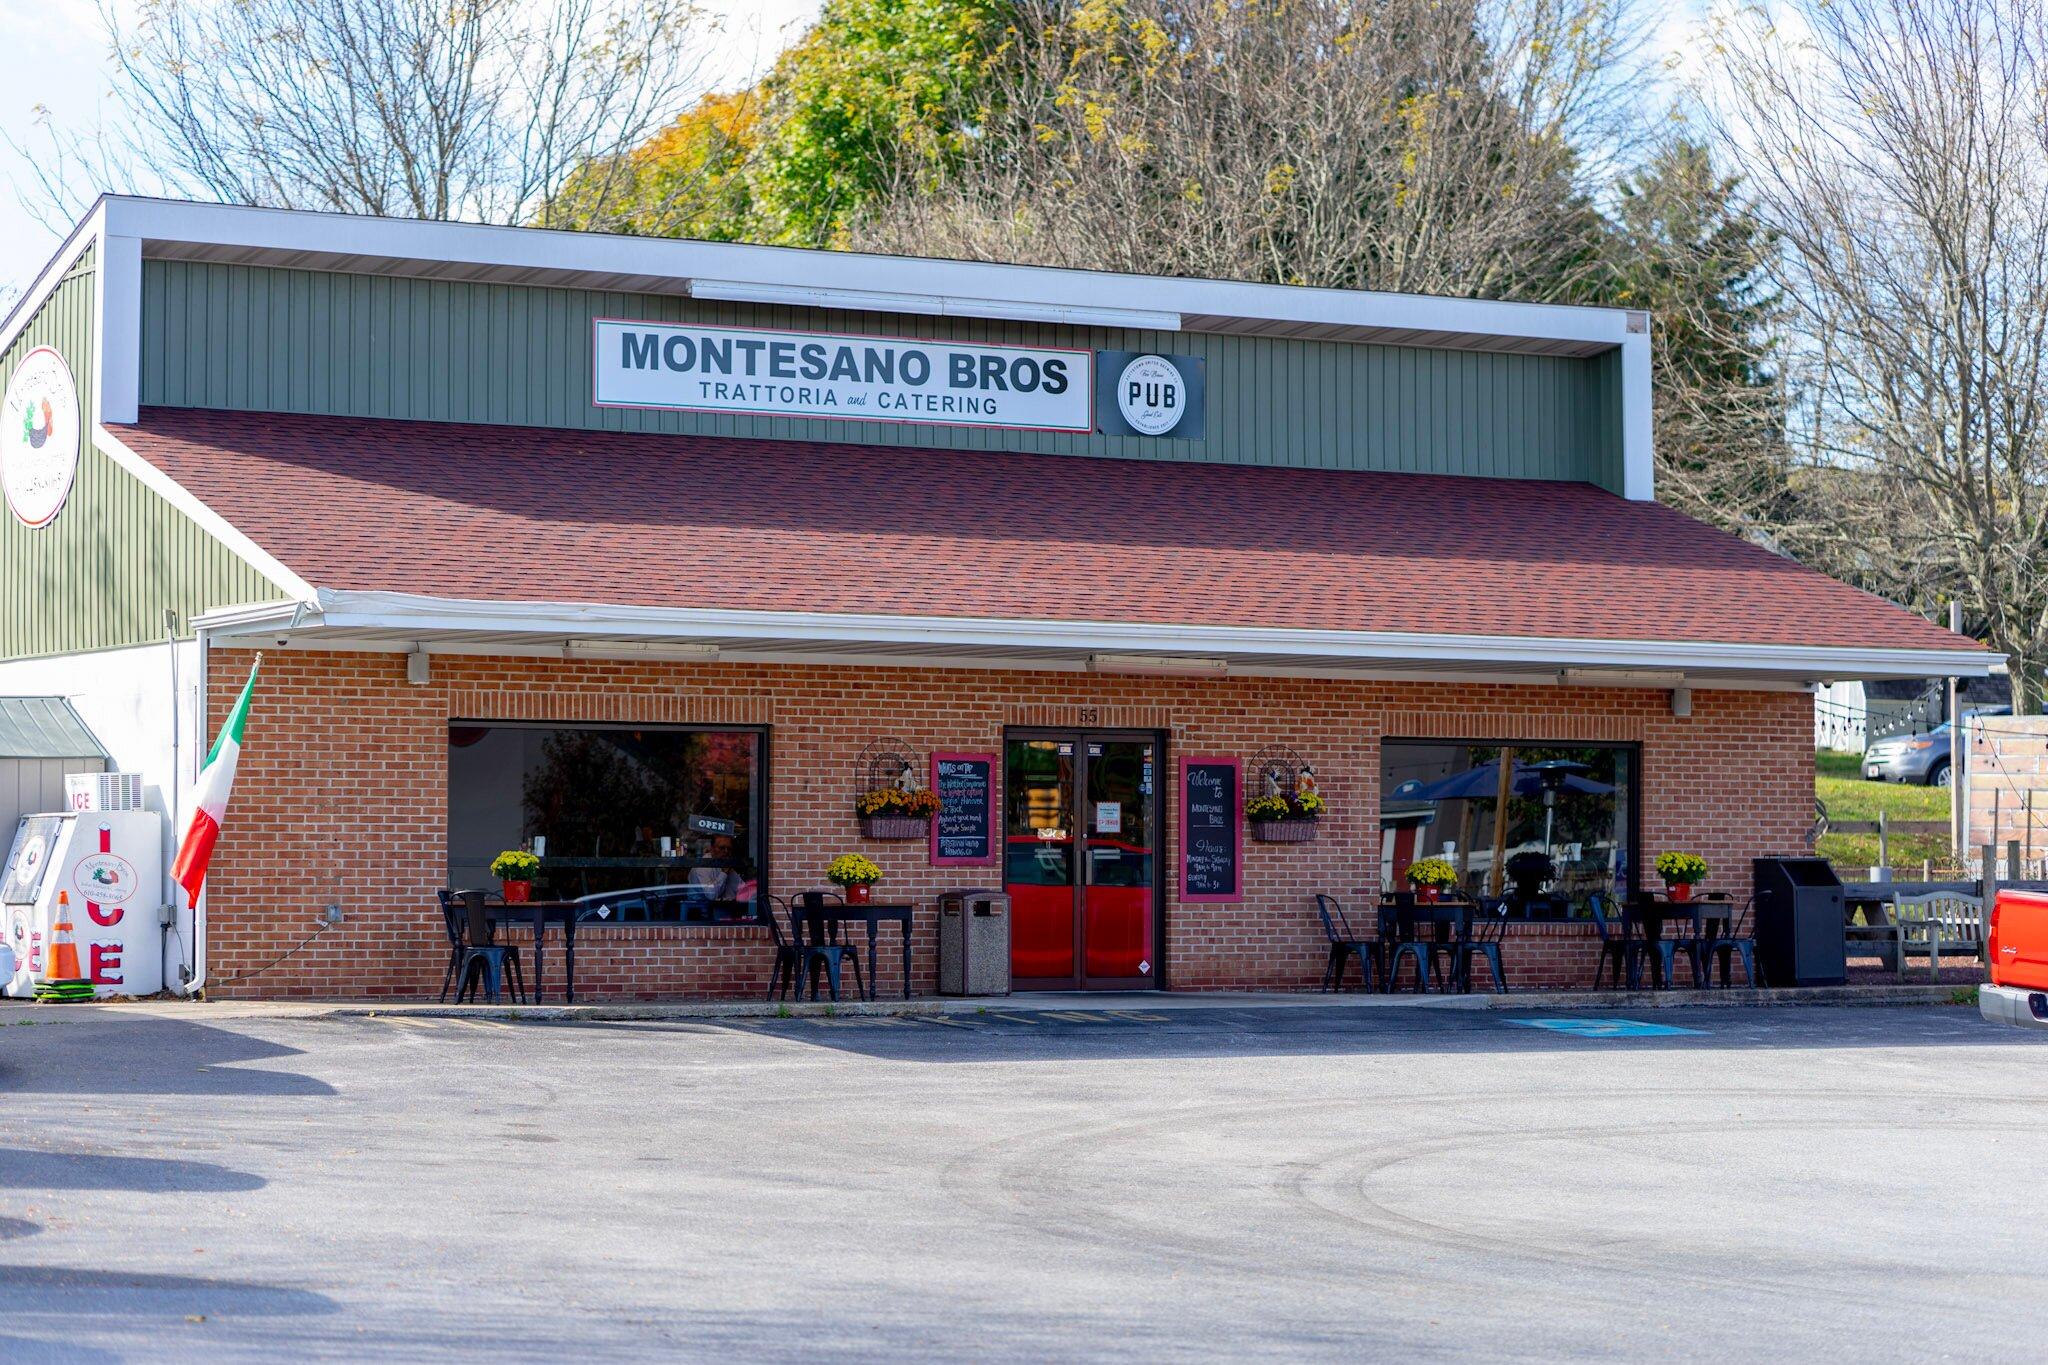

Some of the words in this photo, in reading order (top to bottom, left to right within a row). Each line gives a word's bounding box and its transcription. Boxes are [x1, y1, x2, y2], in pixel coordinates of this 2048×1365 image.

[621, 332, 931, 387] MONTESANO
[949, 352, 1069, 395] BROS
[699, 381, 837, 406] TRATTORIA
[847, 391, 868, 407] and
[878, 391, 997, 415] CATERING
[1129, 381, 1176, 409] PUB
[1080, 709, 1097, 723] 55
[72, 792, 90, 810] ICE
[1213, 786, 1223, 798] to
[698, 819, 726, 831] OPEN
